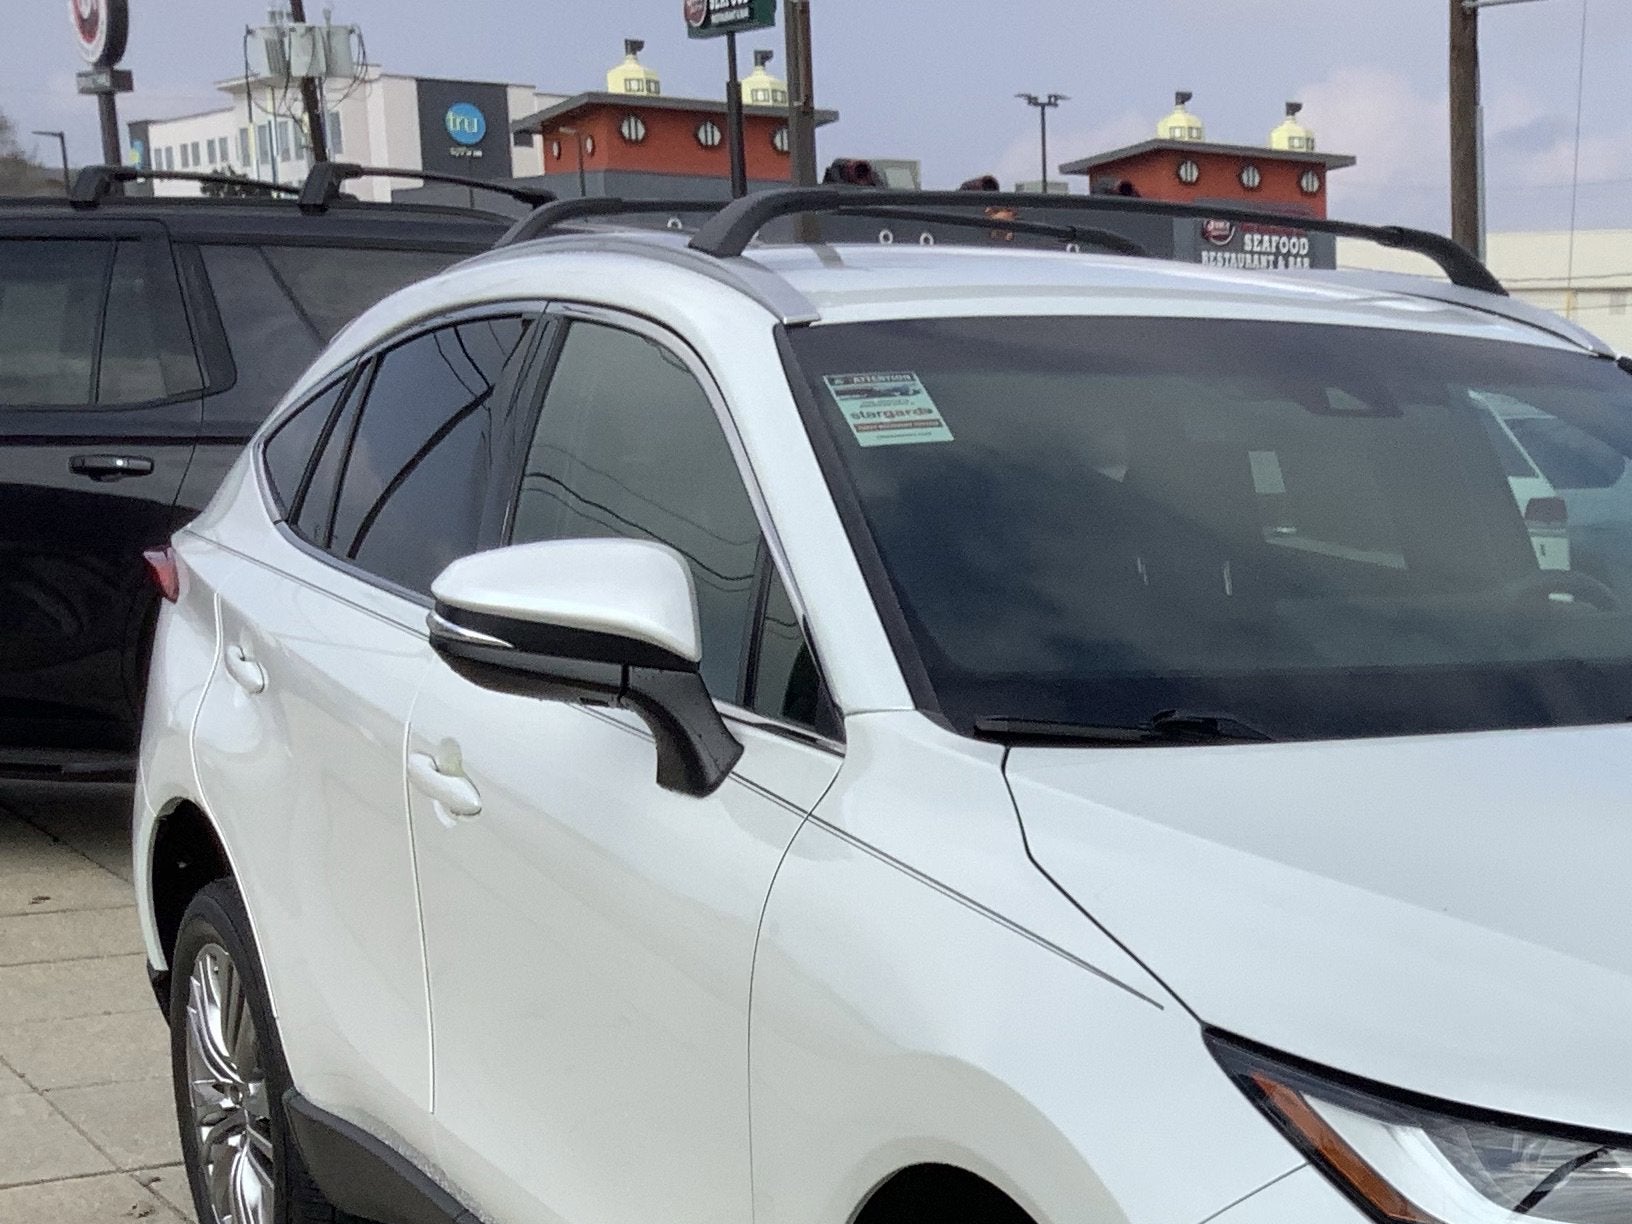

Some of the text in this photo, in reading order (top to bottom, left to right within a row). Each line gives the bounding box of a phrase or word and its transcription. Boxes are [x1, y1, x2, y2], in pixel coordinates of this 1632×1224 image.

[447, 111, 478, 133] tru
[1243, 233, 1310, 255] SEAFOOD
[1201, 250, 1274, 271] RESTAURANT
